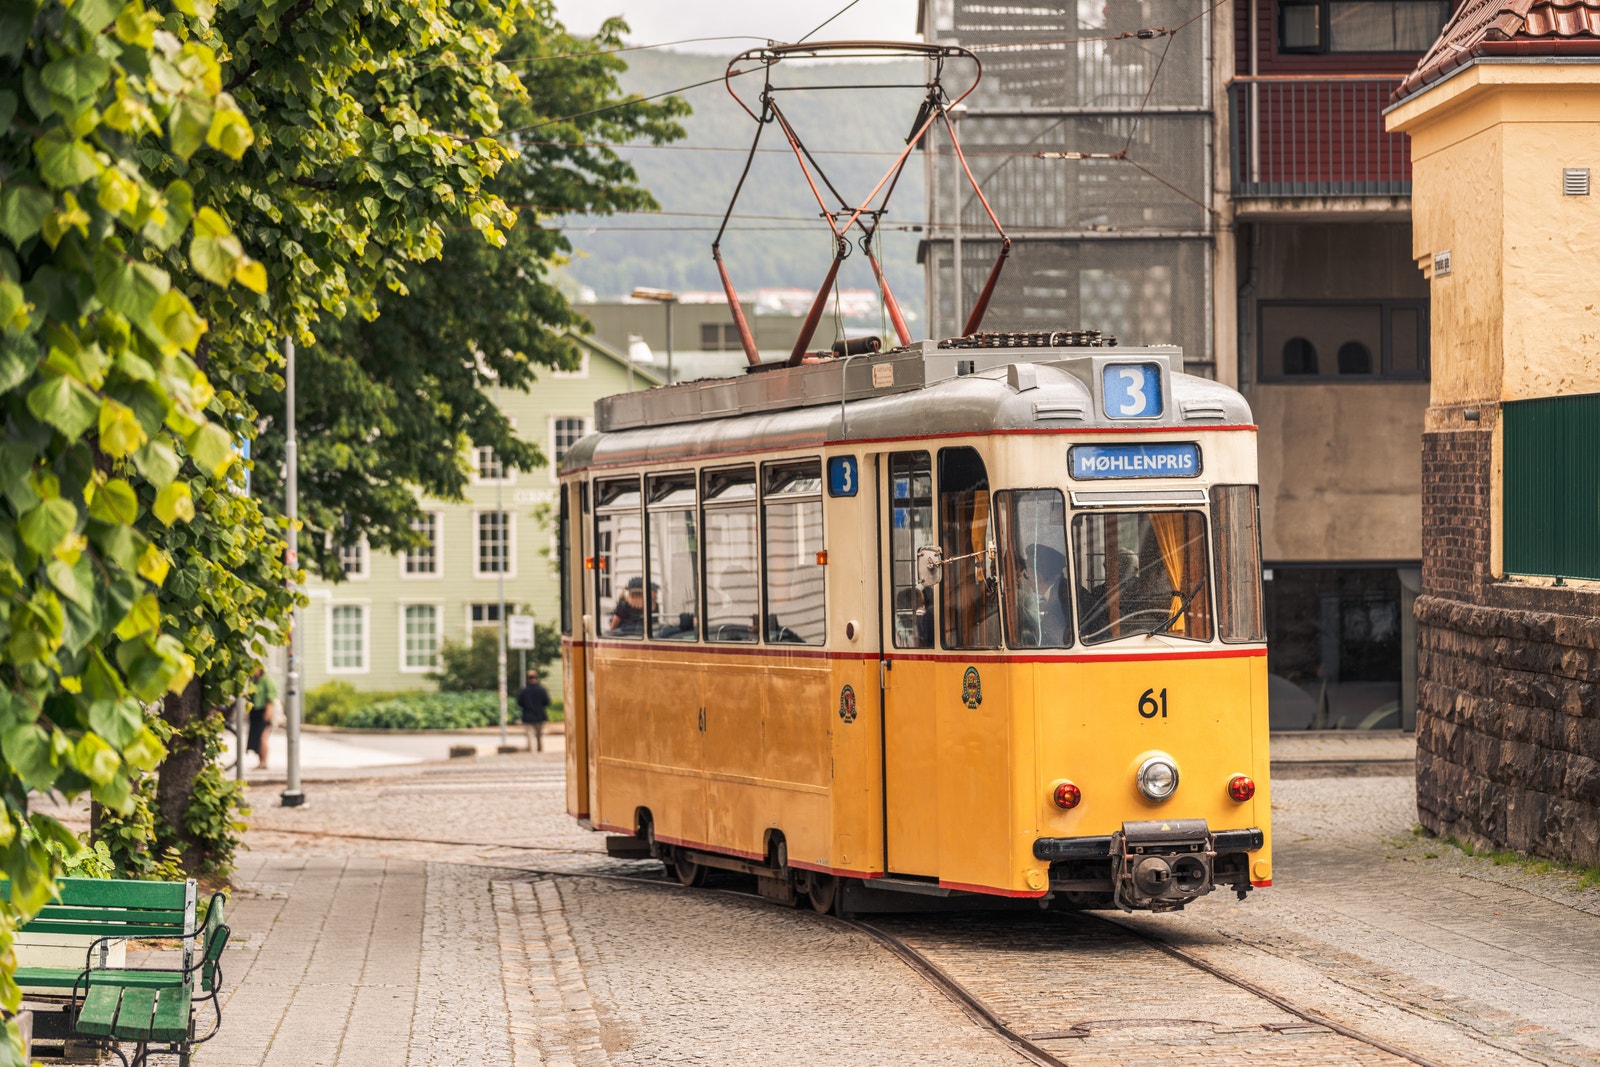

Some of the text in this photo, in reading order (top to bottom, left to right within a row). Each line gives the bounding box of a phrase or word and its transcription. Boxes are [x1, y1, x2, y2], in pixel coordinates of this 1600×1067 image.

[1119, 368, 1147, 416] 3
[842, 461, 852, 492] 3
[1081, 454, 1193, 471] MØHLENPRIS
[1138, 688, 1167, 718] 61
[698, 706, 707, 732] 61
